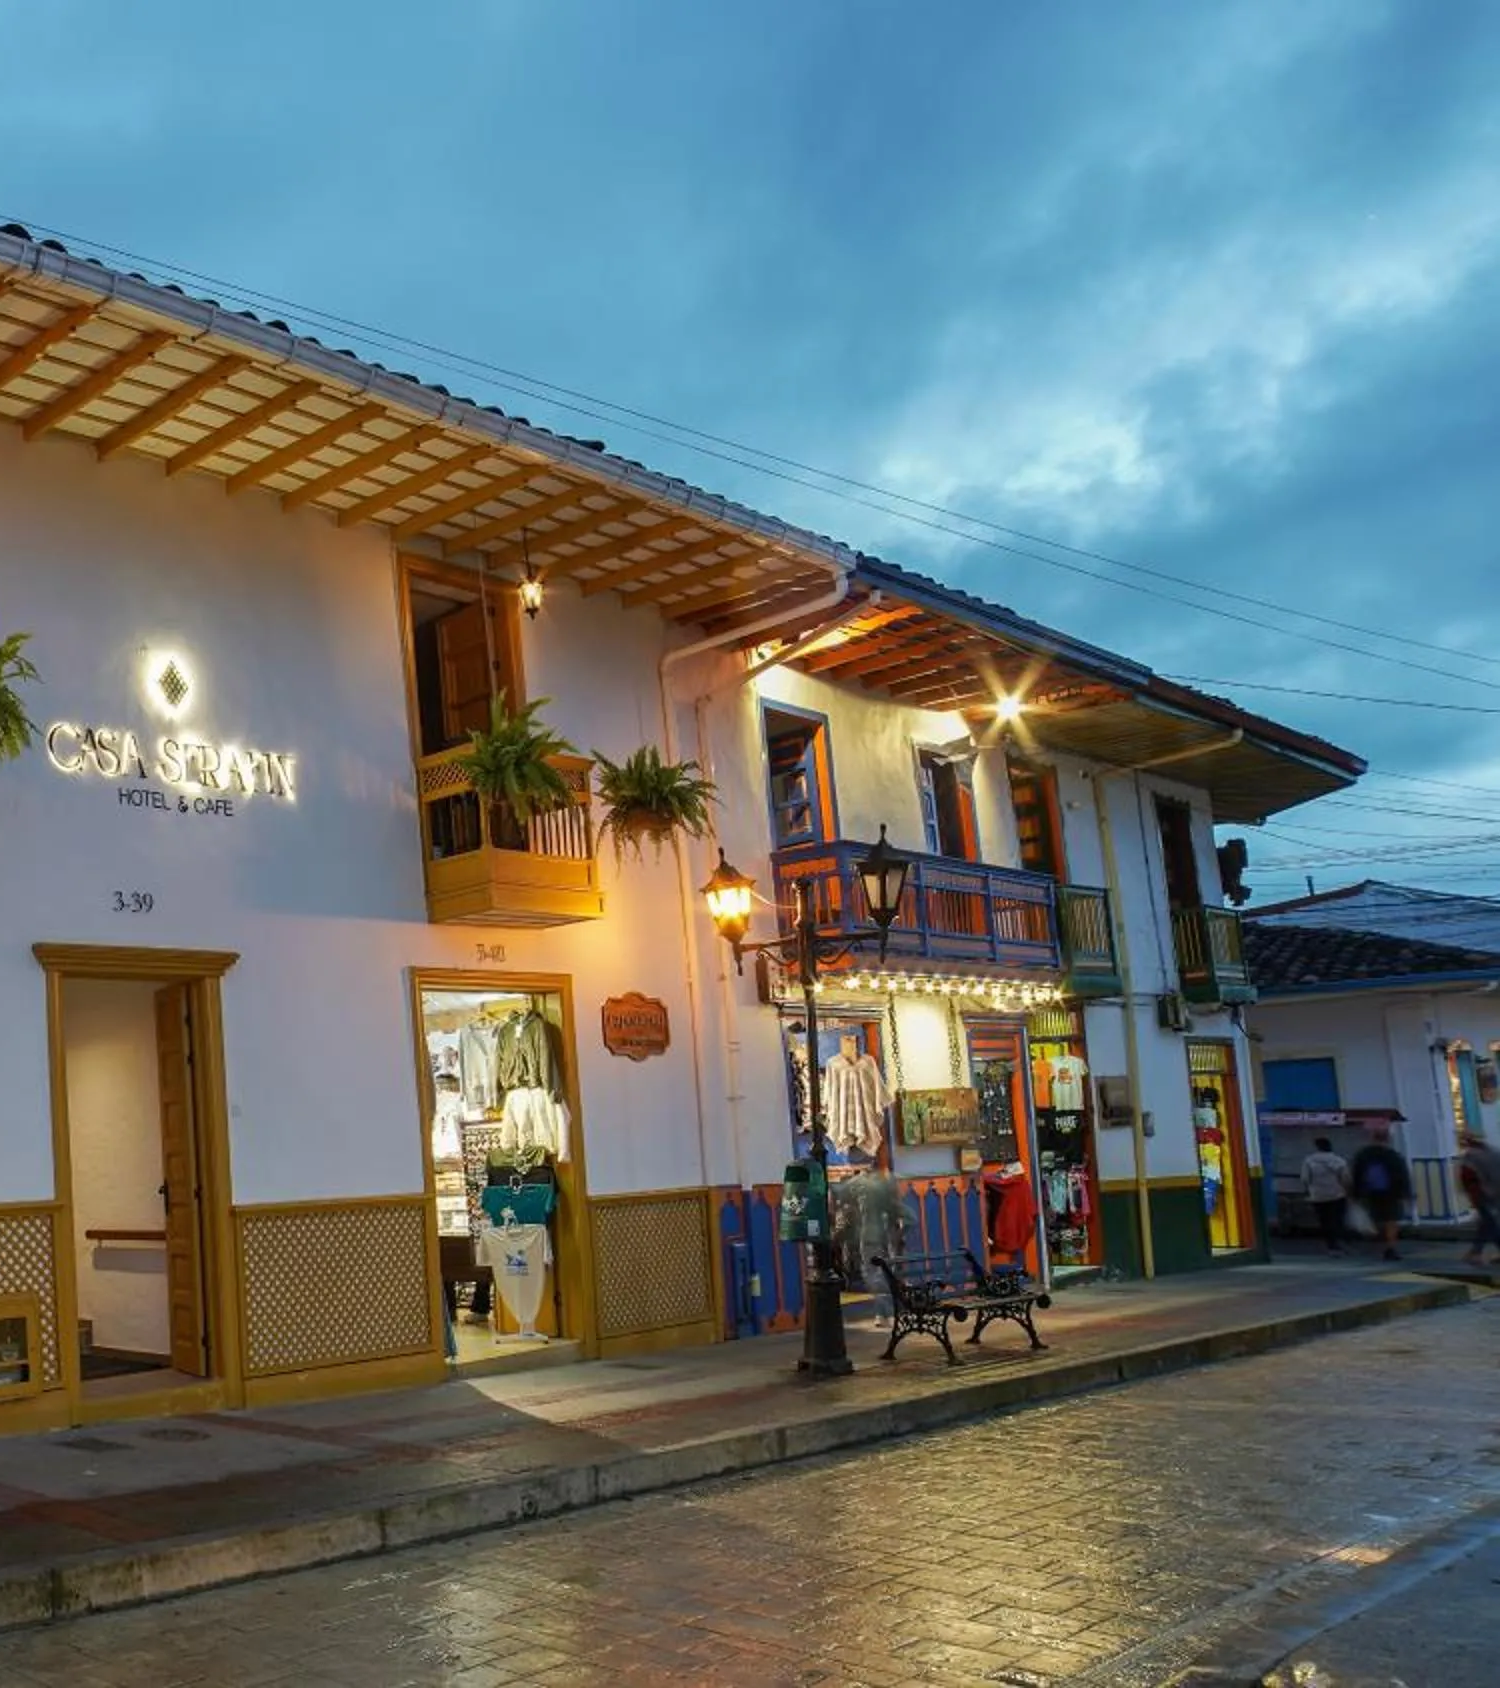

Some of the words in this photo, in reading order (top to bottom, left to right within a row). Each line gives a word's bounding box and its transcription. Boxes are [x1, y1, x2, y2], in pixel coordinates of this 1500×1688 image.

[48, 724, 147, 779] CASA
[118, 787, 171, 811] HOTEL
[177, 795, 189, 813] &
[193, 797, 234, 817] CAFE
[112, 890, 154, 913] 3-39
